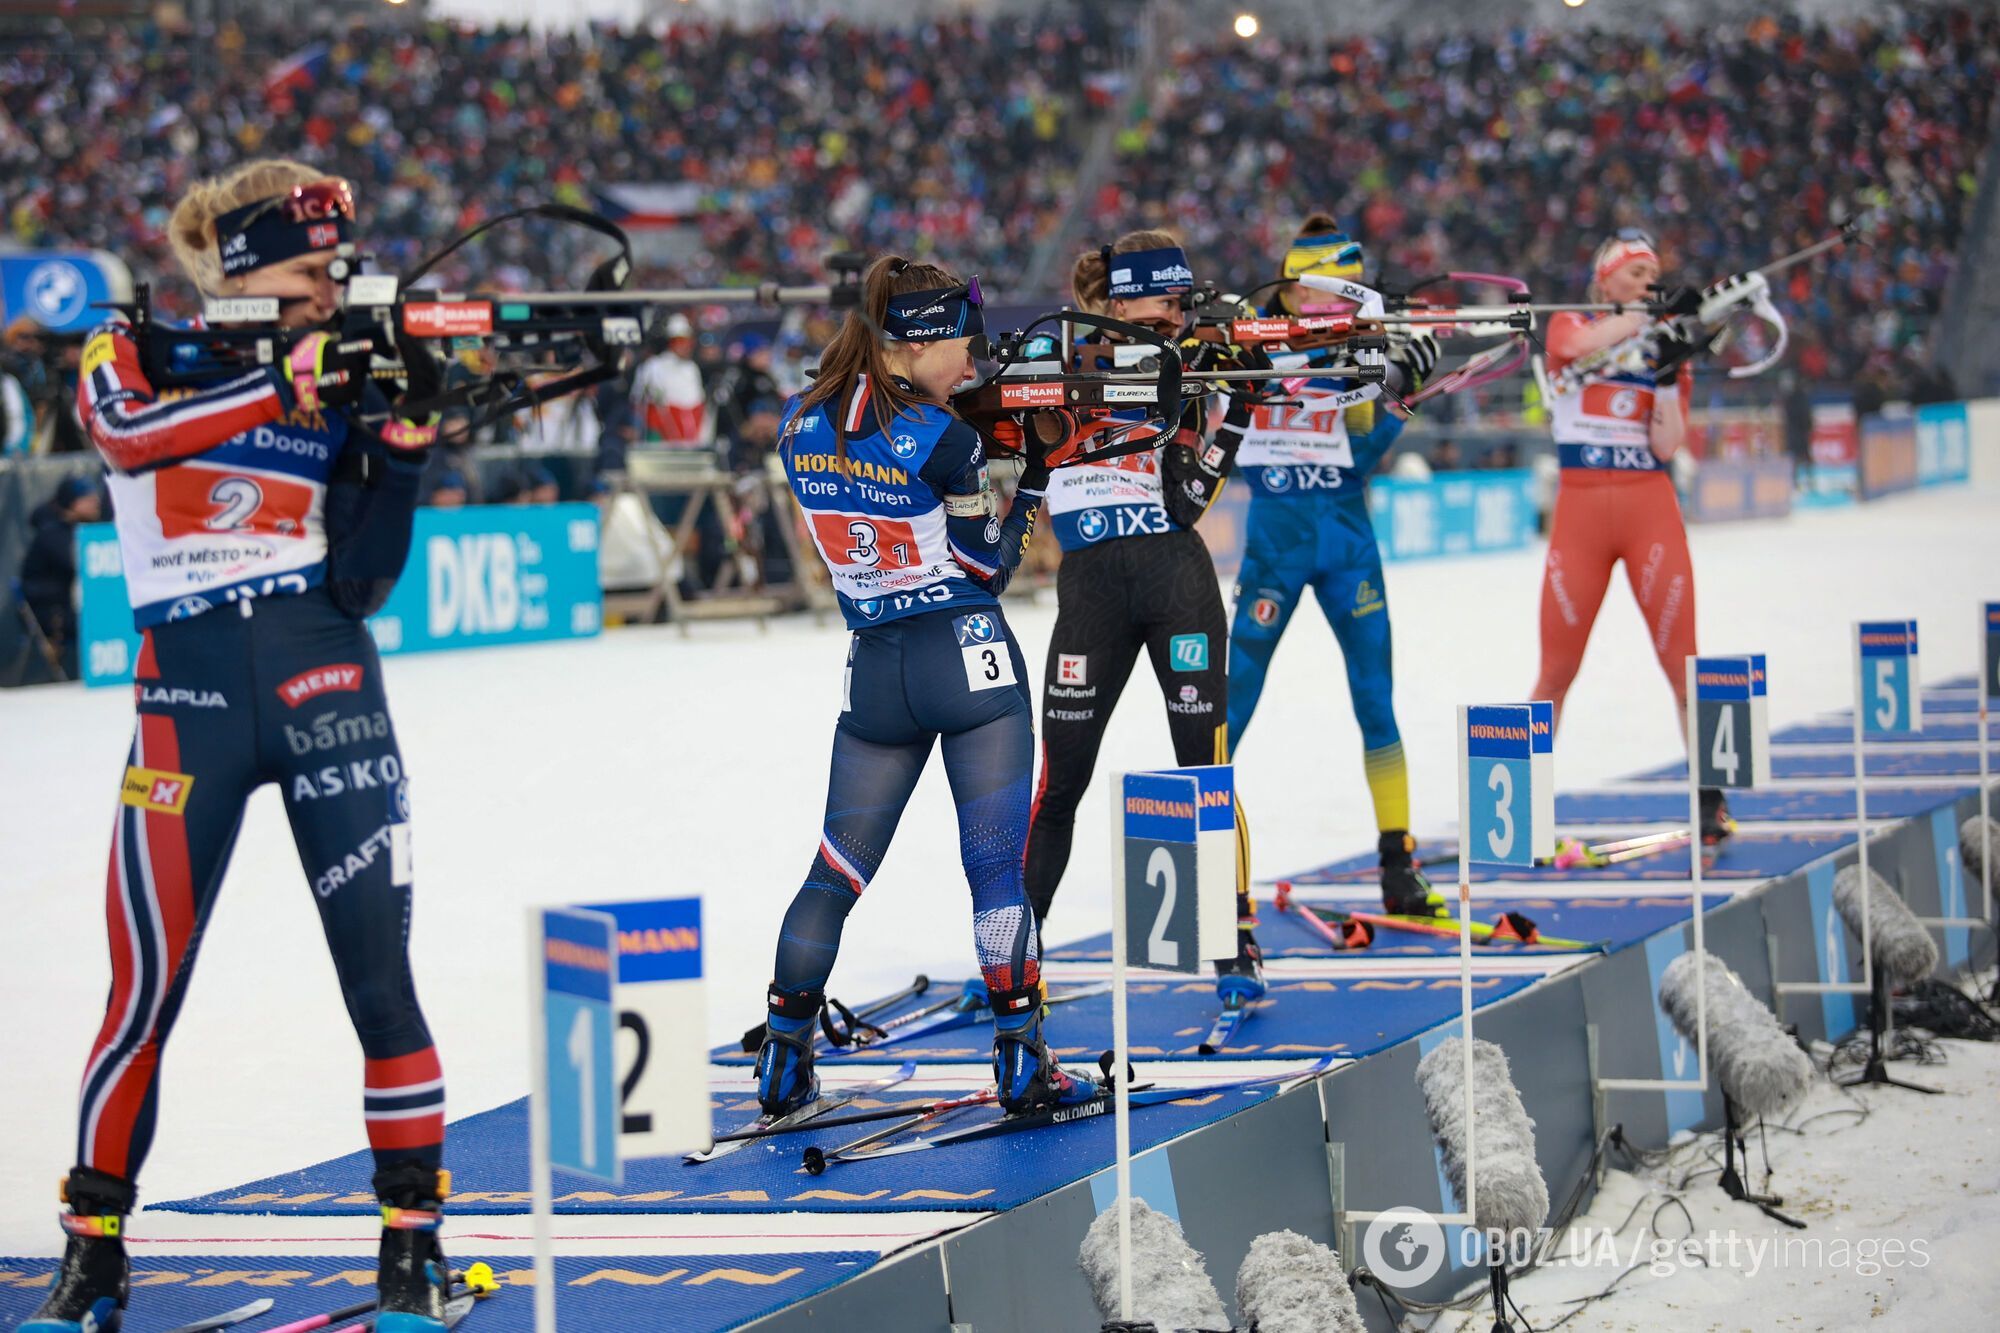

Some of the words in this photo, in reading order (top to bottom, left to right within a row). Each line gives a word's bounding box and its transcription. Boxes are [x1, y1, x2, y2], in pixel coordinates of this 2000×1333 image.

[1342, 285, 1364, 298] JOKA
[906, 327, 946, 337] CRAFT
[1235, 322, 1288, 336] VIESSMANN
[1003, 386, 1062, 401] VIESSMANN
[1336, 391, 1364, 406] JOKA
[1609, 389, 1637, 418] 6
[254, 428, 328, 460] Doors
[794, 453, 908, 486] HÖRMANN
[204, 477, 264, 531] 2
[798, 478, 838, 496] Tore
[857, 482, 911, 506] Türen
[1116, 506, 1170, 536] iX3
[848, 521, 881, 566] 3
[893, 543, 909, 565] 1
[152, 551, 183, 568] NOVÉ
[189, 549, 240, 564] MĚSTO
[427, 532, 518, 638] DKB
[981, 649, 1000, 681] 3
[1175, 639, 1203, 666] TQ
[143, 687, 228, 708] LAPUA
[288, 669, 357, 700] MENY
[1049, 686, 1096, 699] Kaufland
[1876, 660, 1898, 731] 5
[1055, 709, 1095, 721] TERREX
[1168, 700, 1213, 714] tectake
[1712, 704, 1739, 785] 4
[126, 778, 149, 796] Uno
[1126, 796, 1194, 819] HÖRMANN
[1488, 763, 1514, 859] 3
[316, 825, 392, 897] CRAFT
[1145, 846, 1178, 966] 2
[619, 1010, 653, 1134] 2
[567, 1006, 597, 1169] 1
[1052, 1101, 1105, 1124] SALOMON
